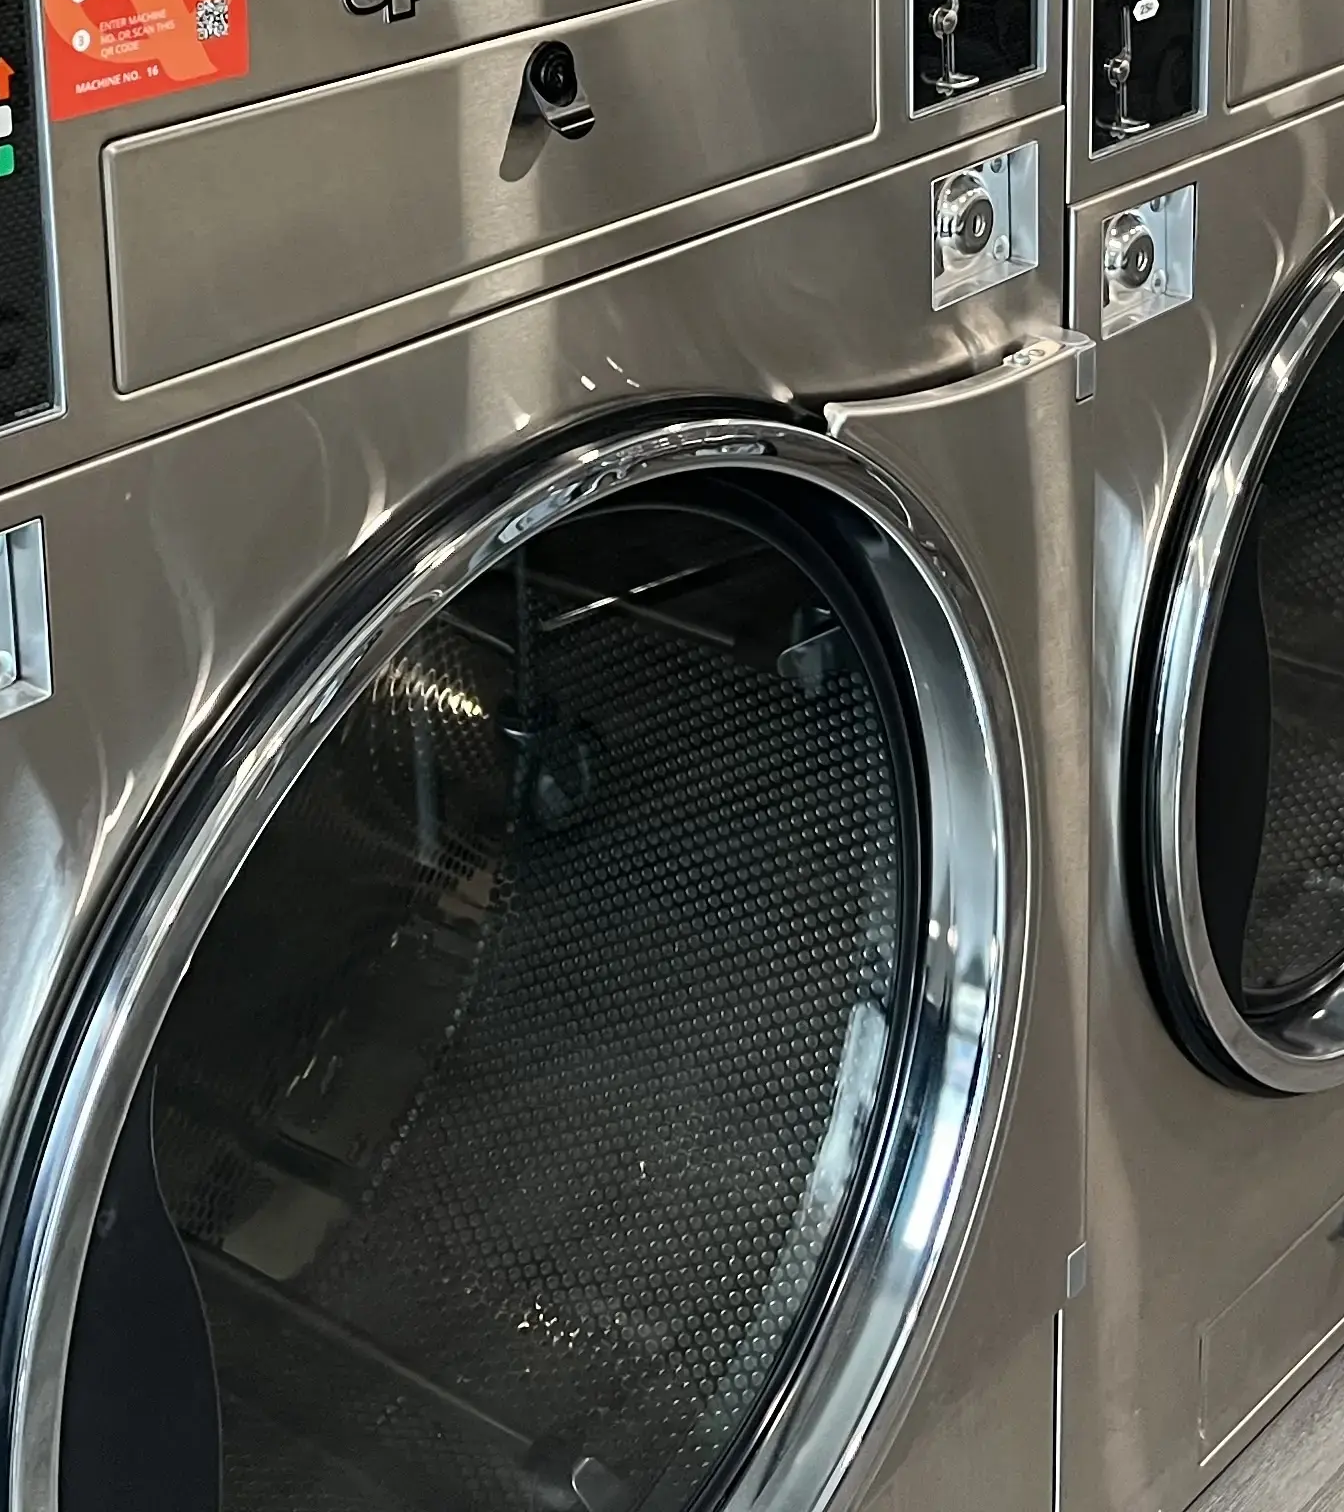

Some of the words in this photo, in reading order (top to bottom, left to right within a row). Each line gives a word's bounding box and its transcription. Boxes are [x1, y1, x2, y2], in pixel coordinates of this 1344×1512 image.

[100, 18, 126, 31] ENTER
[118, 31, 130, 41] OR
[133, 24, 155, 37] SCAN
[115, 42, 139, 54] CODE
[76, 74, 121, 94] MACHINE
[147, 65, 158, 77] 16
